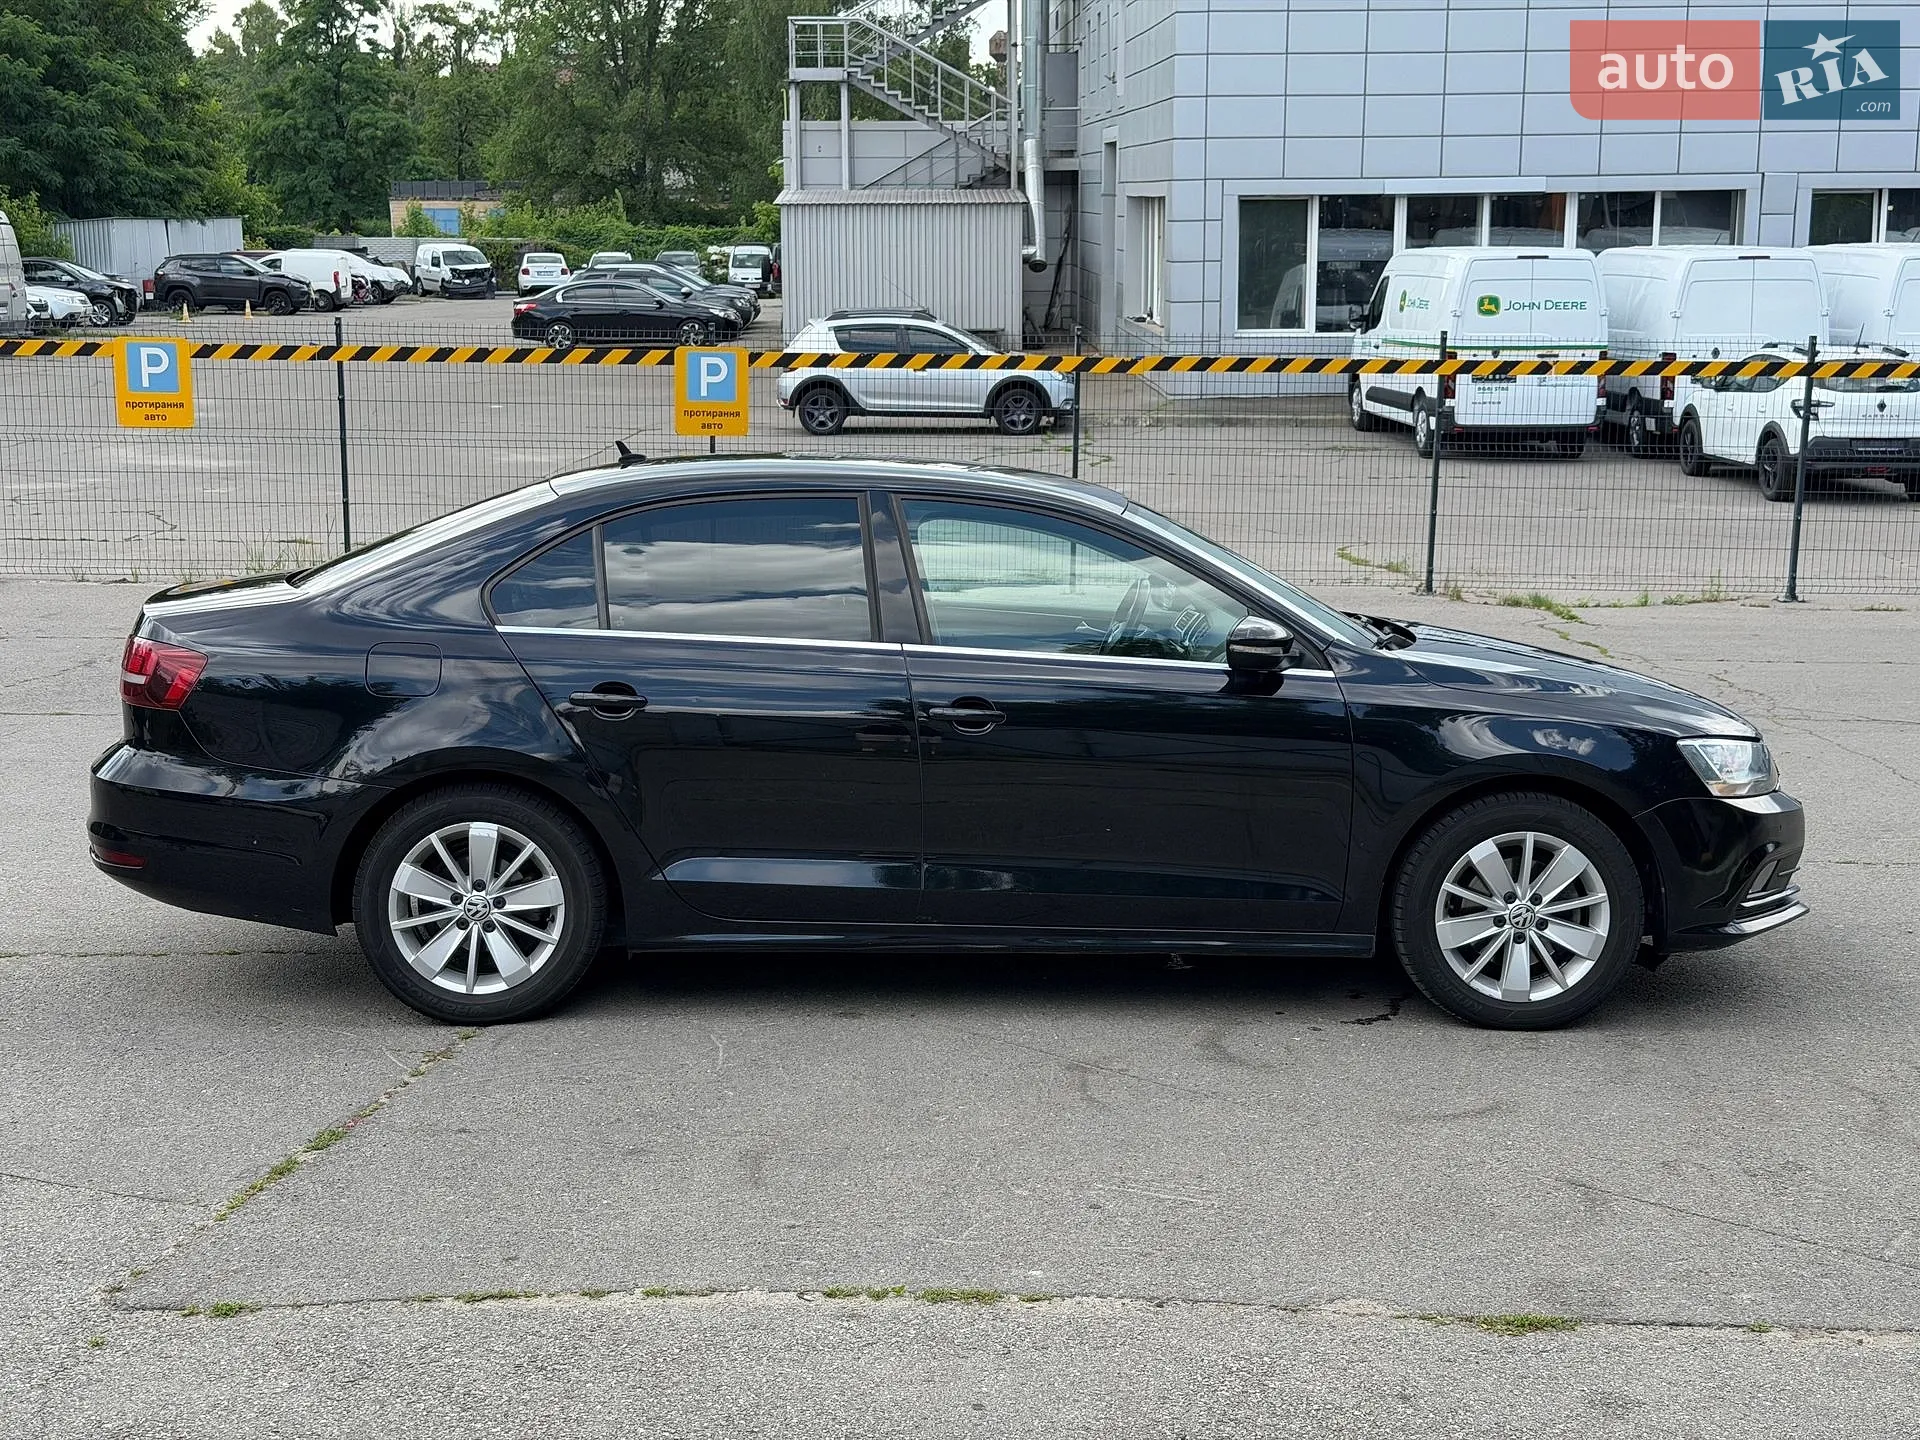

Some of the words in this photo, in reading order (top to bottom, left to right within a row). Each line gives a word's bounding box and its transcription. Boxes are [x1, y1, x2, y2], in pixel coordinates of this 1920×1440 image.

[1504, 300, 1541, 312] JOHN
[1544, 300, 1587, 311] DEERE
[140, 347, 170, 388] P
[700, 356, 729, 397] P
[125, 400, 185, 411] протирання
[144, 413, 168, 421] авто
[683, 409, 741, 419] протирання
[700, 422, 724, 430] авто
